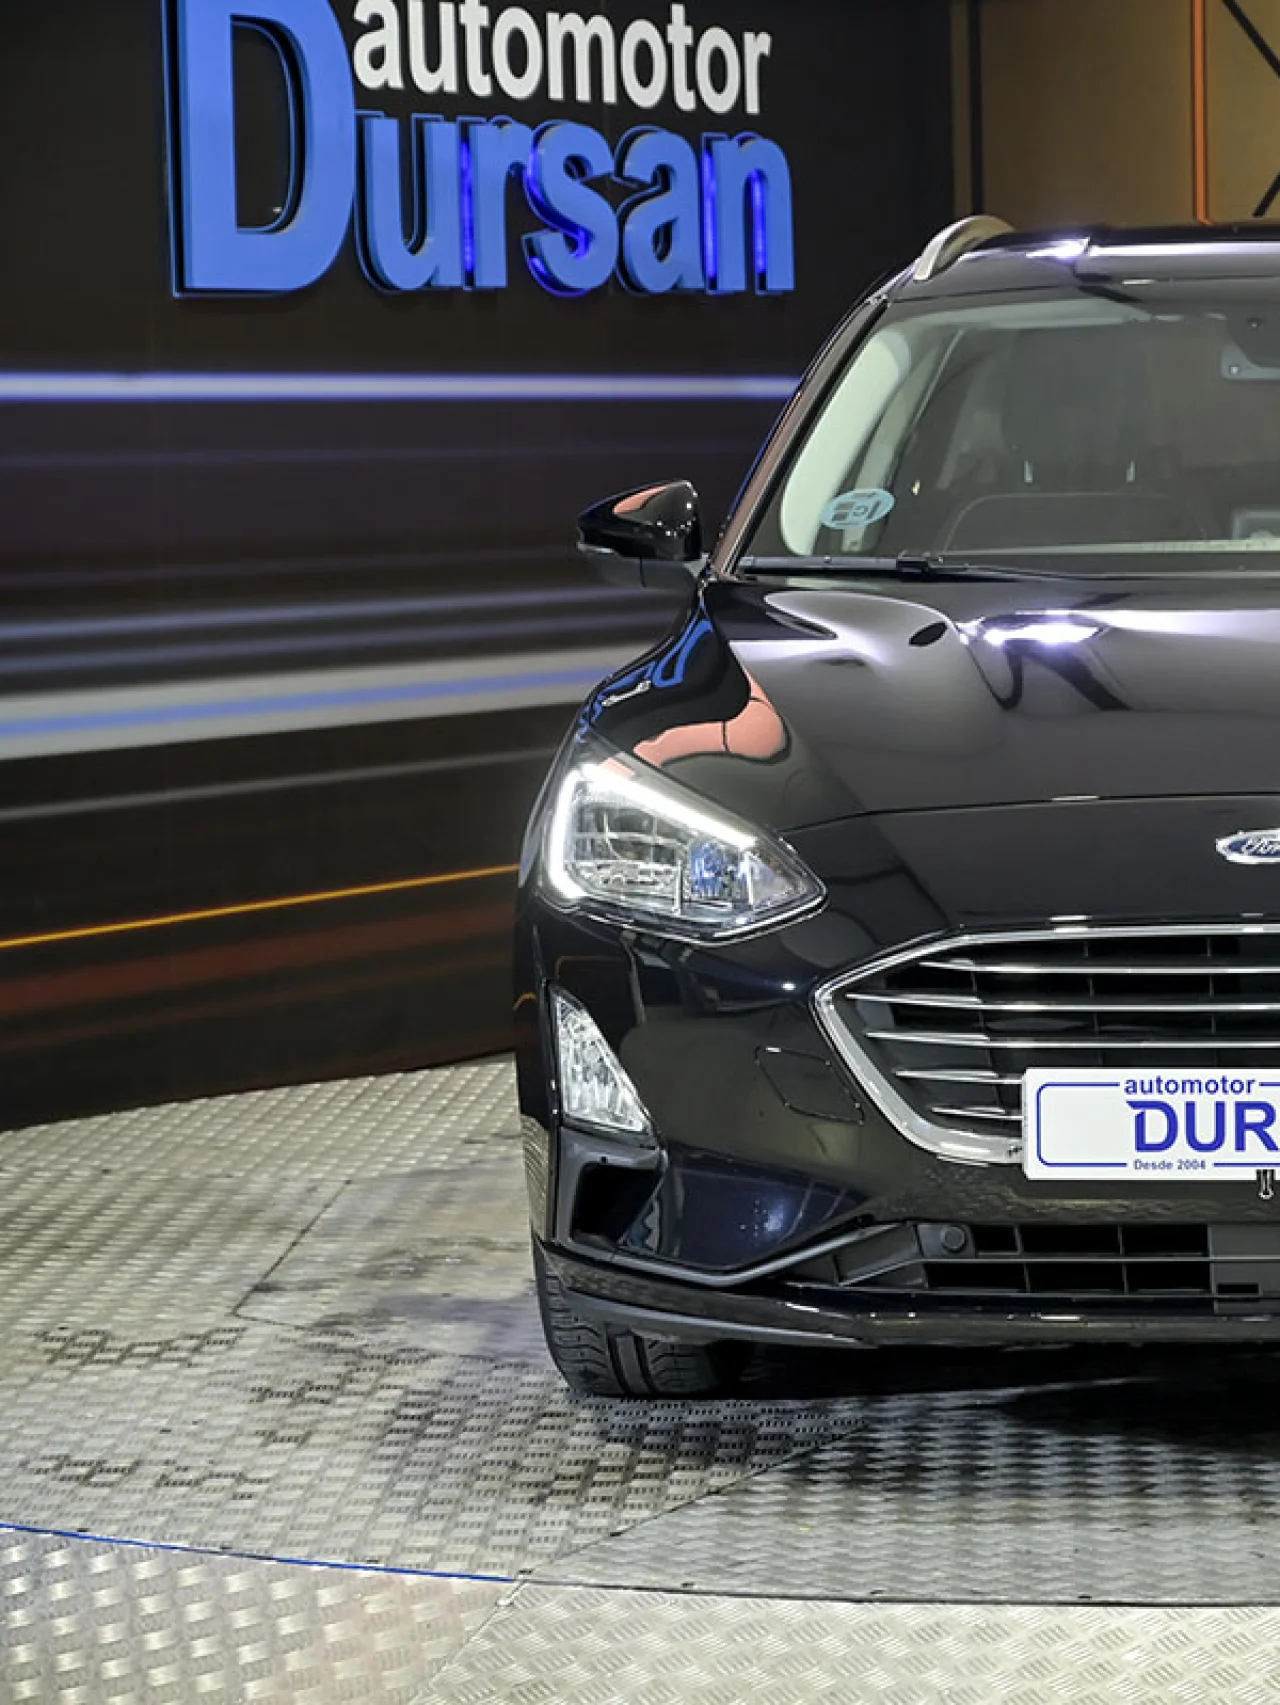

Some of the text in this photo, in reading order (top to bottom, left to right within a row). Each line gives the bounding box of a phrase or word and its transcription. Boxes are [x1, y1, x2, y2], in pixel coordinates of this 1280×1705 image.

[353, 0, 772, 114] automotor
[162, 0, 796, 298] Dursan
[1124, 1075, 1256, 1095] automotor
[1133, 1158, 1207, 1171] Desde 2004
